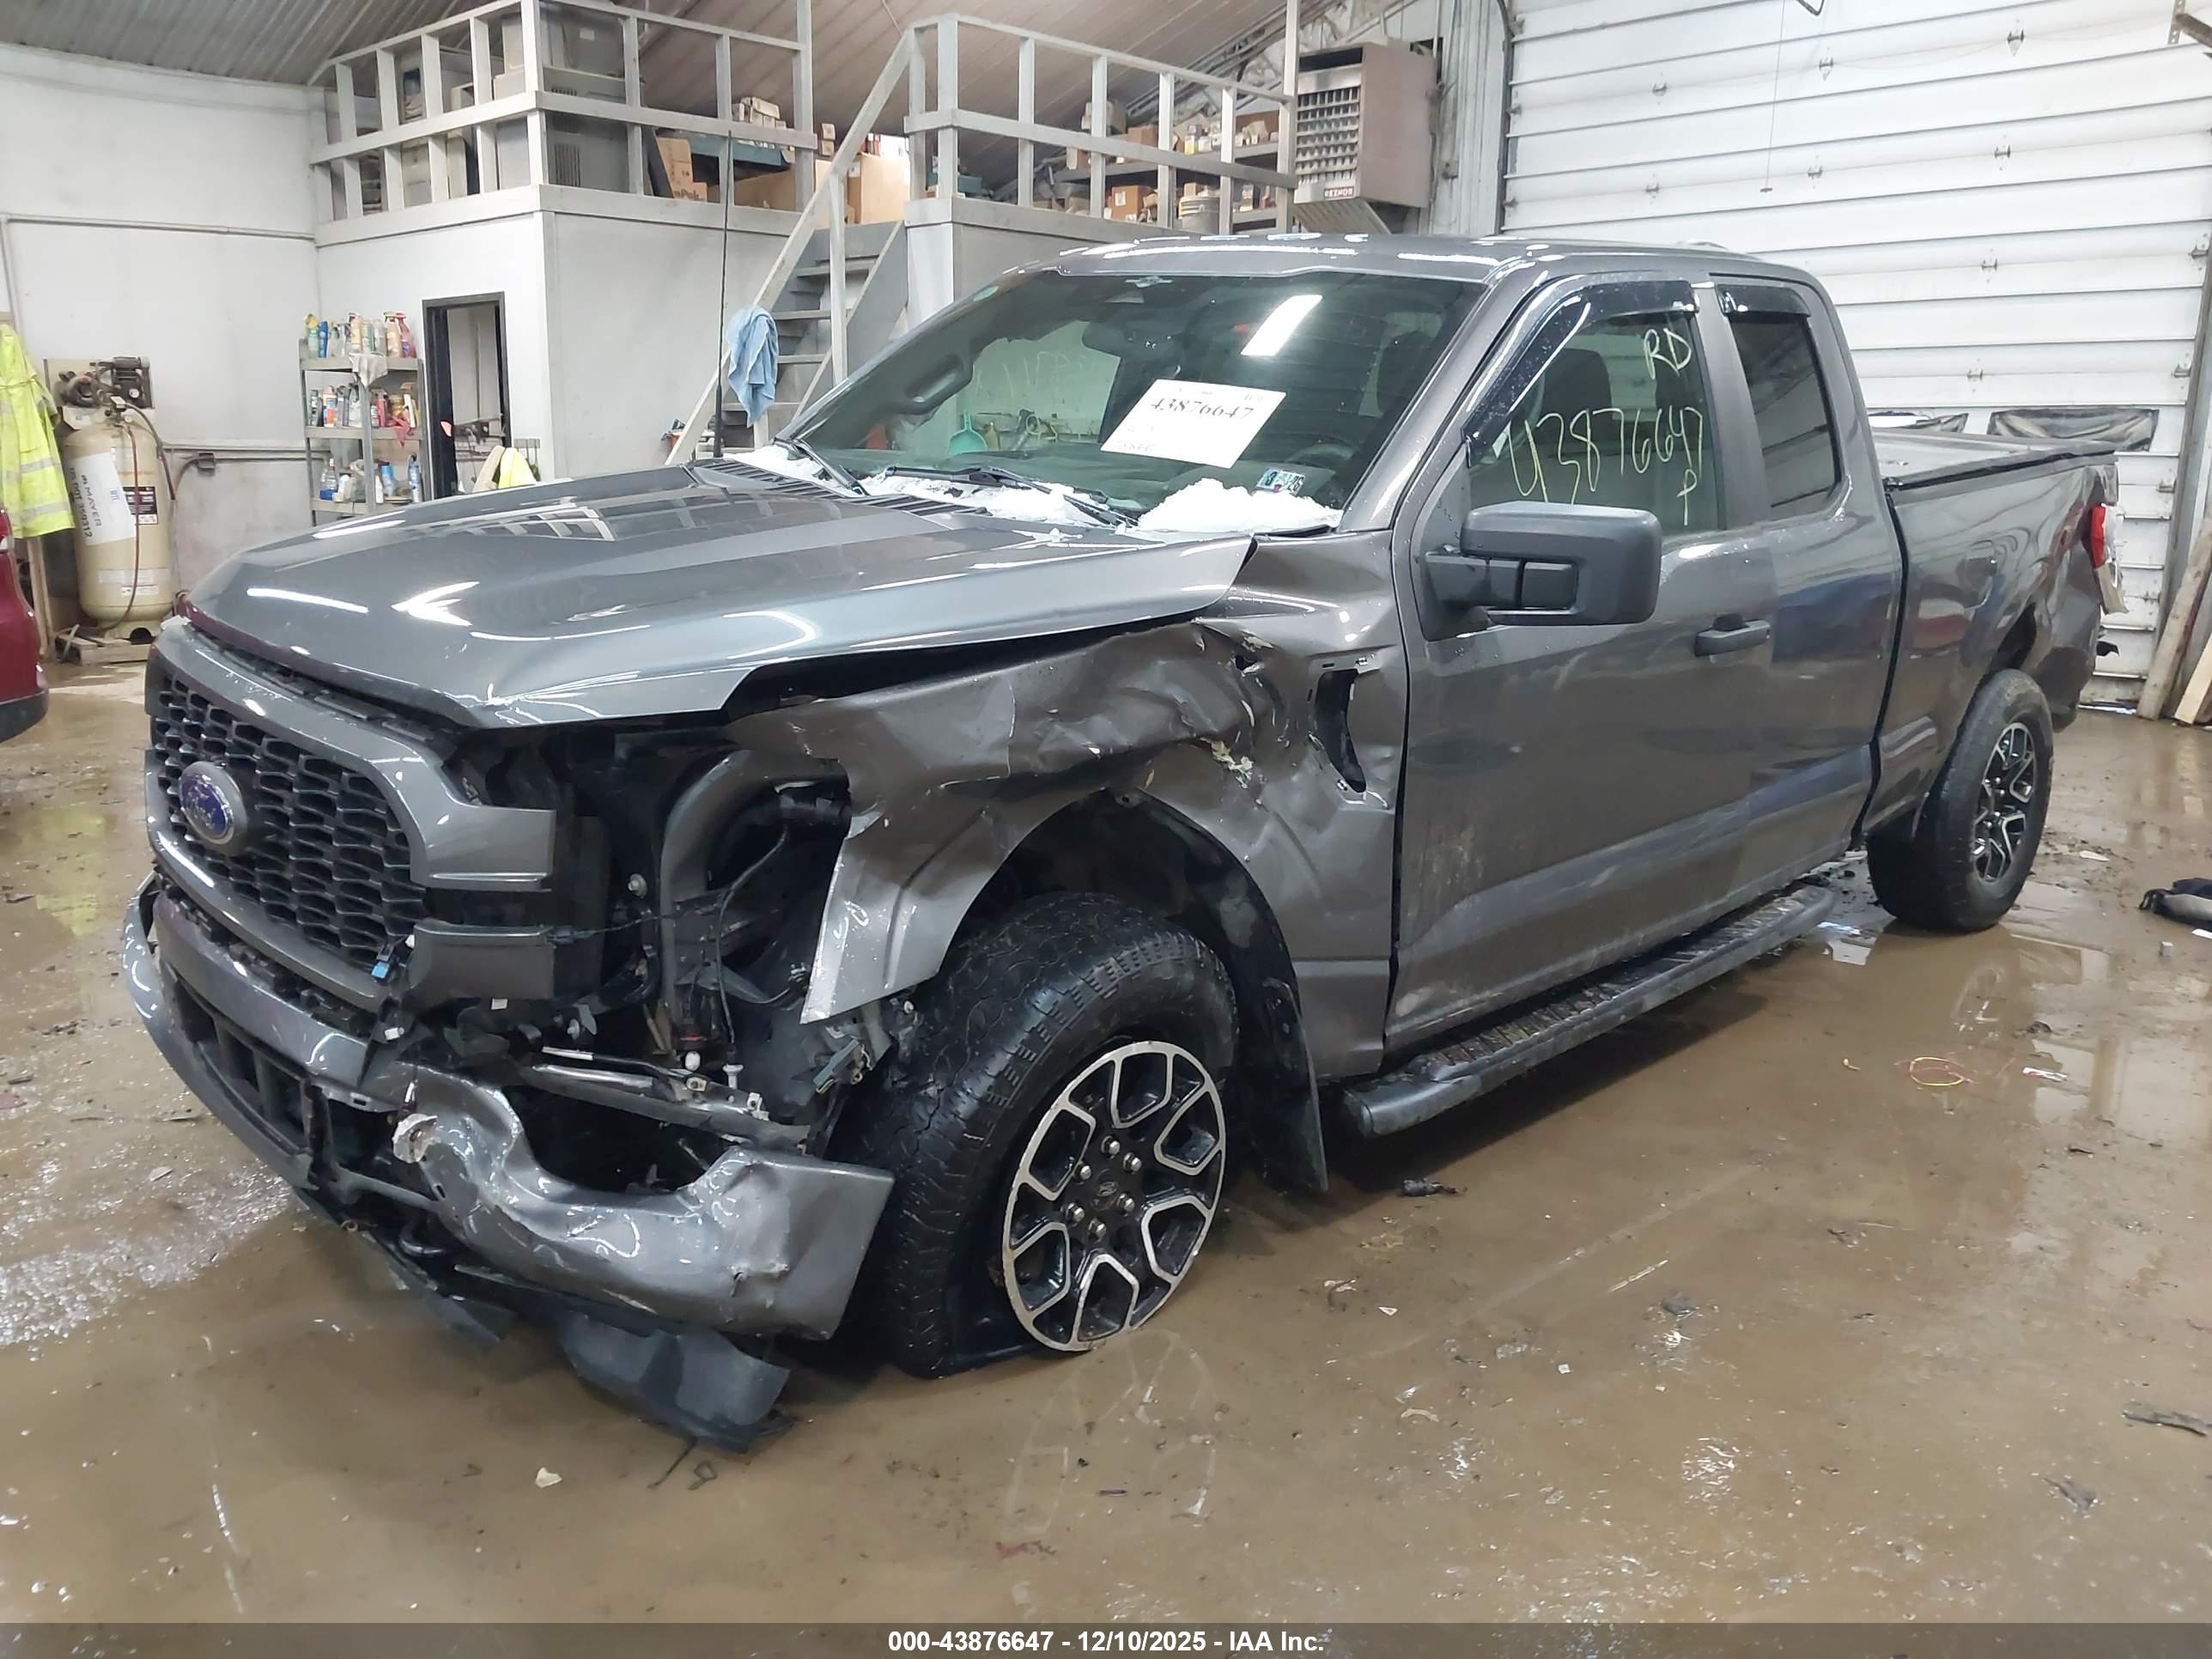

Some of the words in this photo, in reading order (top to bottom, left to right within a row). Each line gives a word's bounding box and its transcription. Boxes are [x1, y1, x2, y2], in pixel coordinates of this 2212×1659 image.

[1644, 327, 1692, 380] RD
[1151, 398, 1255, 419] 43876647
[1508, 404, 1703, 505] 43876647
